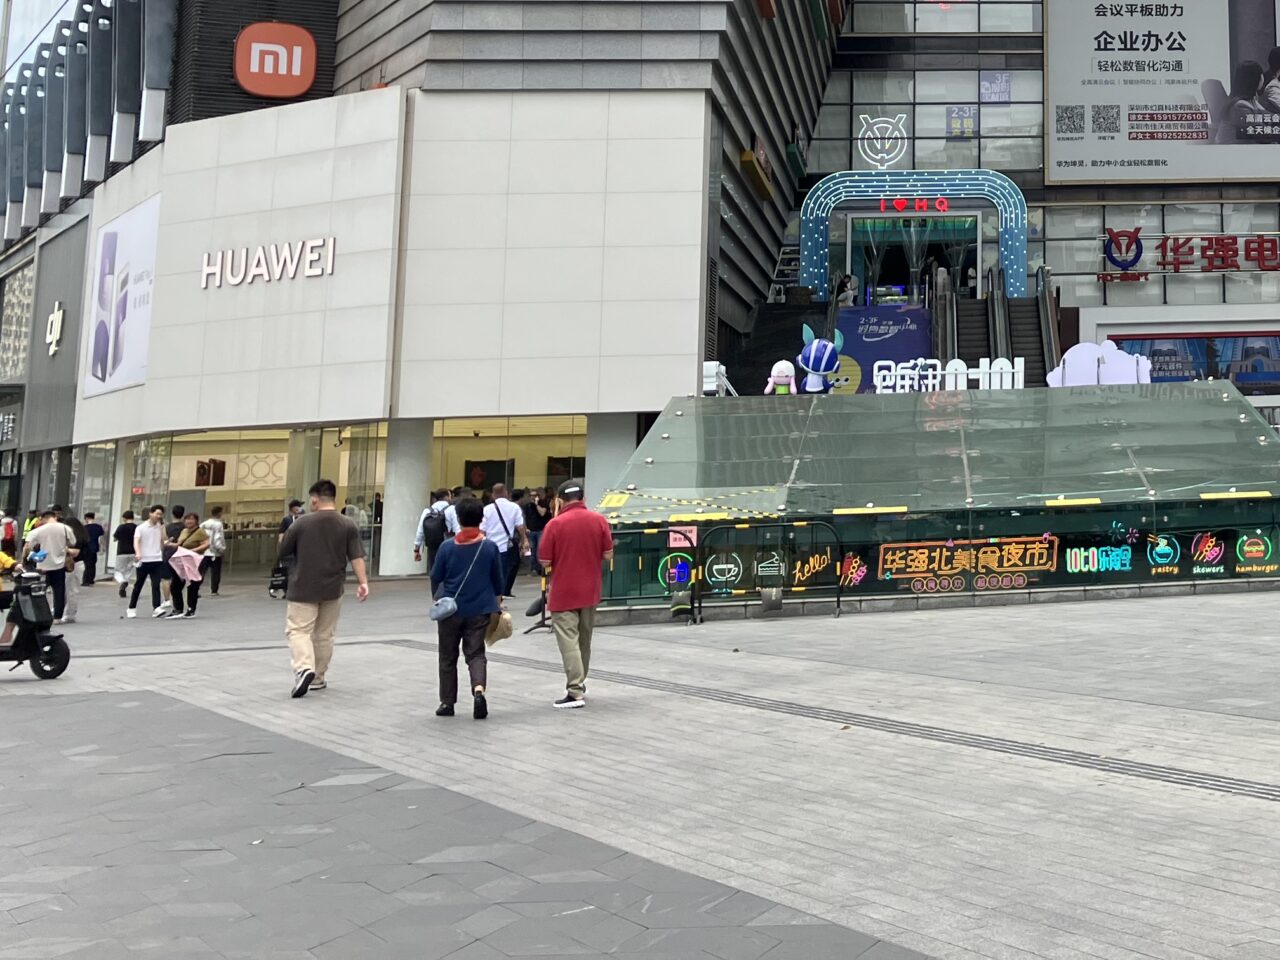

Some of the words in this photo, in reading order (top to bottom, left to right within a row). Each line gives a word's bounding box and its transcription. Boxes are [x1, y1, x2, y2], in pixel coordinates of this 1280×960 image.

[1094, 3, 1184, 17] 会议平板助力
[1093, 30, 1187, 52] 企业办公
[1097, 59, 1184, 72] 轻松数智化沟通
[951, 107, 978, 117] 2-3F
[1153, 113, 1207, 121] 15915726103
[1153, 132, 1208, 140] 18925252835
[201, 237, 336, 290] HUAWEI
[884, 541, 1052, 573] 华强北美食夜市
[792, 546, 832, 586] hello!
[1151, 565, 1179, 576] pastry
[1192, 565, 1225, 575] skewers
[1235, 563, 1280, 575] hamburger
